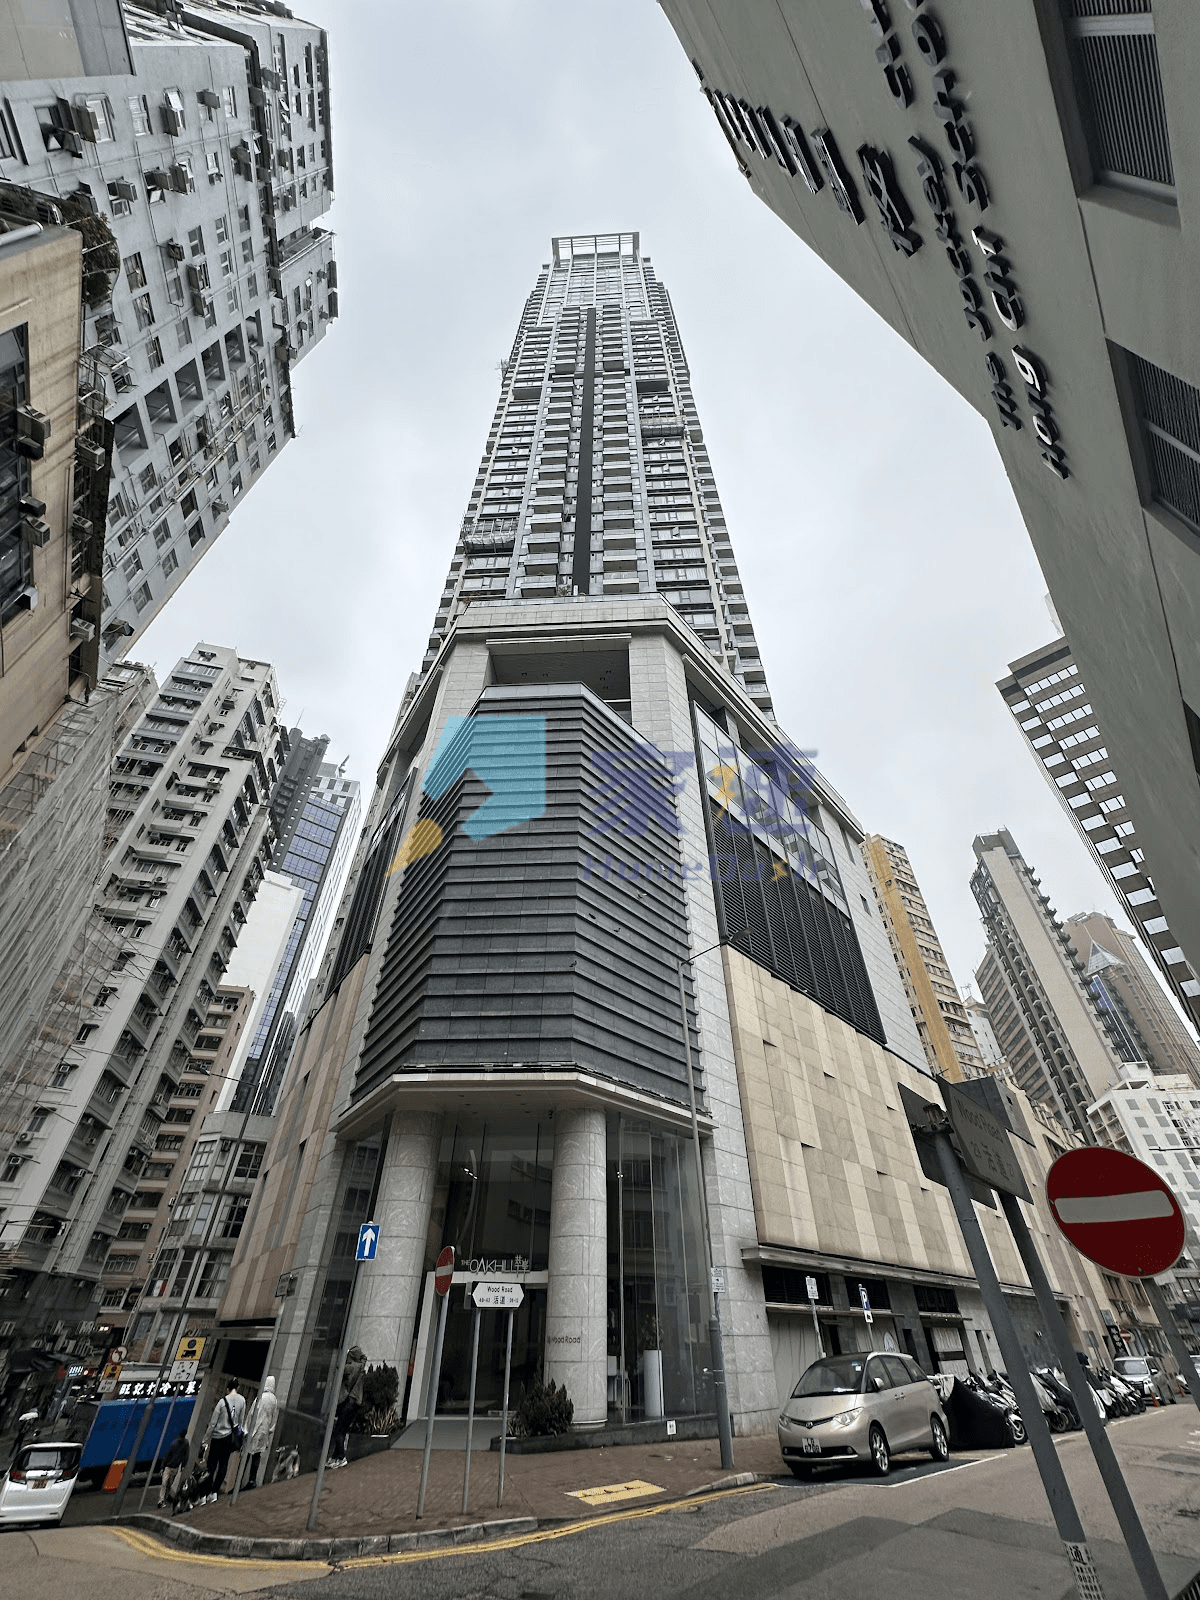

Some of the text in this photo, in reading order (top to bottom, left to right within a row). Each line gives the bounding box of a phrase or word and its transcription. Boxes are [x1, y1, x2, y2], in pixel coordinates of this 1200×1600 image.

[904, 0, 1069, 480] Hong Chi Scho
[907, 134, 993, 342] Jockey
[984, 351, 1022, 431] The
[469, 1256, 531, 1275] OAKHILL
[487, 1285, 514, 1293] Wood Road
